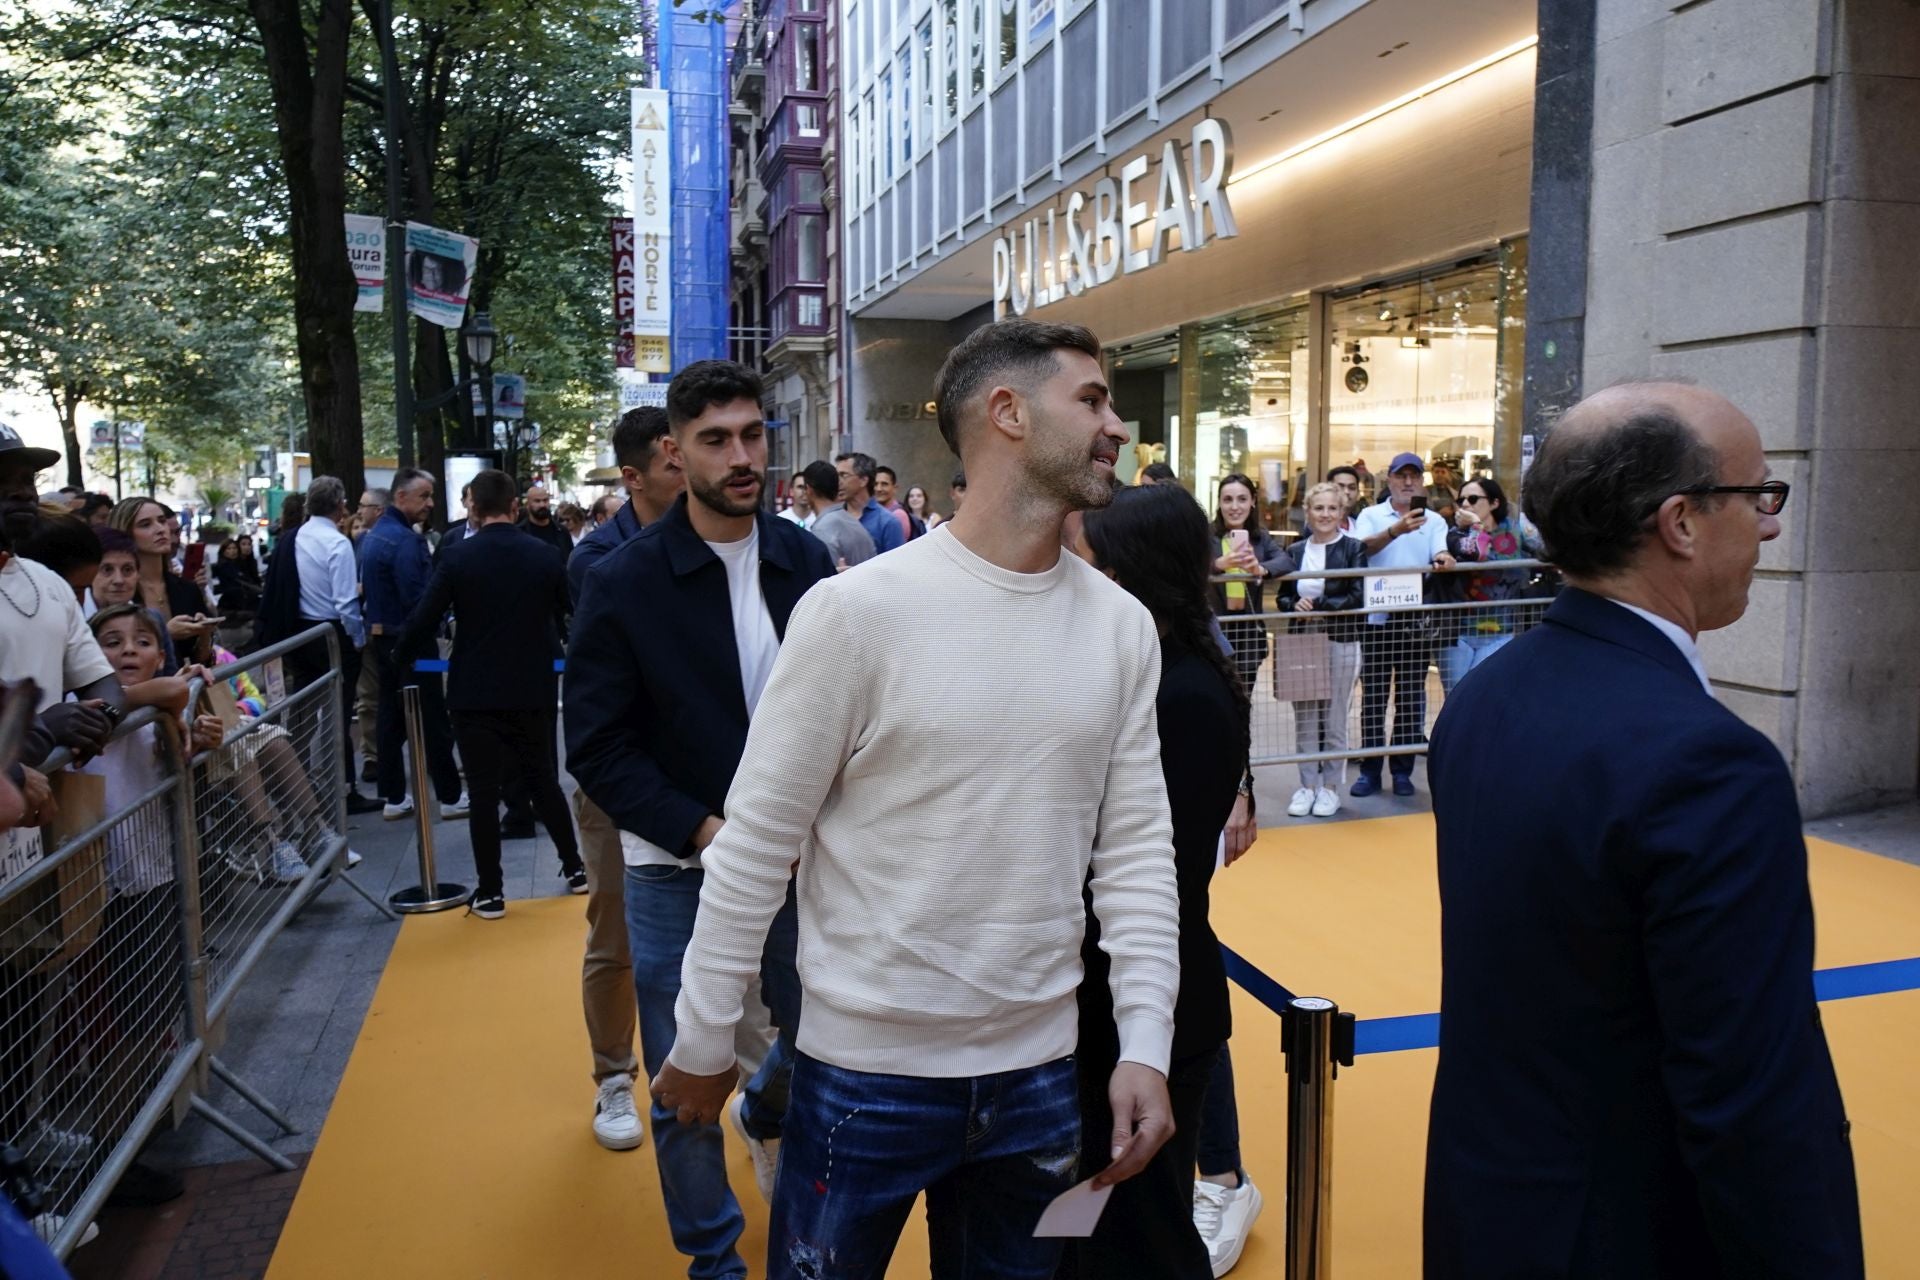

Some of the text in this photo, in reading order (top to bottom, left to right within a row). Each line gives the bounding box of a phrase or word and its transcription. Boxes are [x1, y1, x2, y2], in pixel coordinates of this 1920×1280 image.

[642, 138, 658, 216] ATLAS
[993, 118, 1238, 323] PULL&BEAR
[347, 248, 381, 262] ura
[352, 262, 381, 272] orum
[644, 231, 660, 311] NORTE
[1370, 593, 1419, 606] 944 711 441
